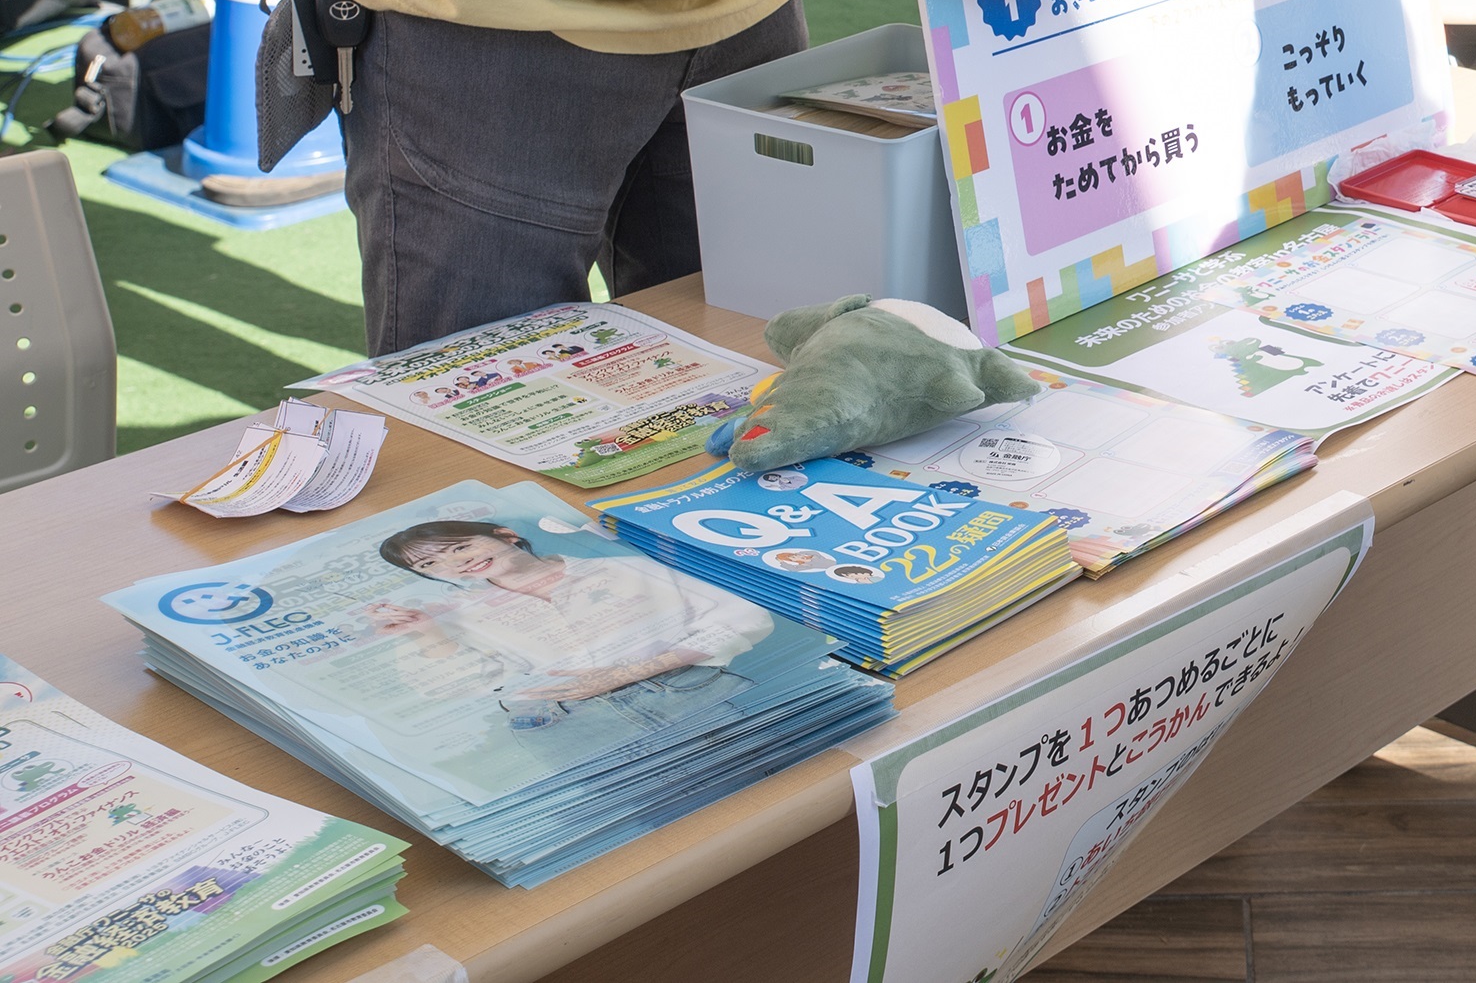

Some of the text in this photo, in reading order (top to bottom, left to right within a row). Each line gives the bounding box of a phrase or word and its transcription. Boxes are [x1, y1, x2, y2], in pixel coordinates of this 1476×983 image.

[1282, 24, 1346, 71] こっそり
[1287, 59, 1368, 112] もっていく
[1047, 108, 1113, 157] お金を
[1052, 123, 1199, 200] ためてから買う
[1126, 250, 1247, 303] ワニーサと学ぶ
[1303, 350, 1397, 394] アンケートに
[1003, 452, 1032, 462] 金融庁
[671, 482, 928, 548] Q&A
[833, 493, 972, 563] BOOK
[879, 510, 1015, 585] 22の疑問
[210, 610, 313, 647] J-FLEC
[239, 626, 343, 663] お金の知識を
[253, 633, 357, 671] あなたの力に
[937, 612, 1285, 829] スタンプを1つあつめるごとに
[936, 626, 1305, 877] 1つプレゼントとこうかんできるよ!
[42, 827, 140, 880] うんこお金ドリル
[36, 877, 225, 981] 金融経済教育
[45, 888, 174, 956] 金融庁ワニーサの
[122, 922, 169, 948] 2025
